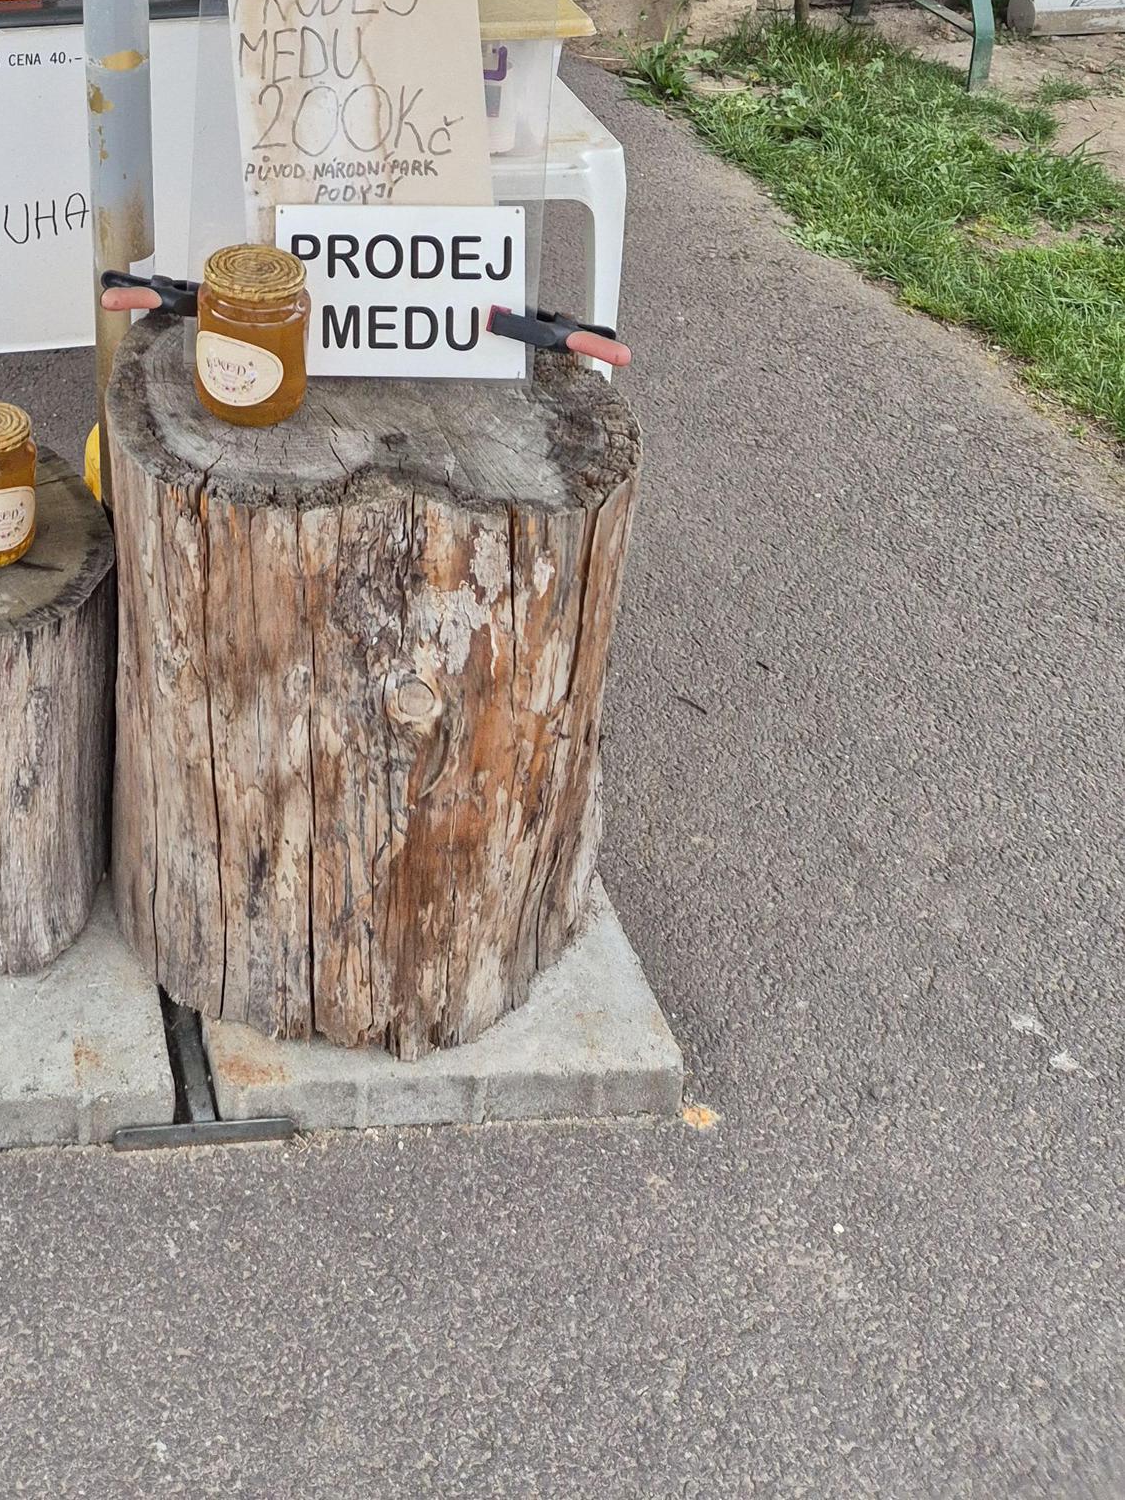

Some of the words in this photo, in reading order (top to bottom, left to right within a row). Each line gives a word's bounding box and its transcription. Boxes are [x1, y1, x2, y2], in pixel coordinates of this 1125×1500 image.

[8, 52, 41, 67] CENA
[238, 25, 363, 83] MEDU
[244, 155, 306, 182] PŮVOD
[312, 151, 395, 180] NÁRODNÍ
[390, 158, 438, 177] PARK
[314, 175, 403, 205] PODYJÍ
[291, 233, 513, 281] PRODEJ
[322, 304, 480, 351] MEDU
